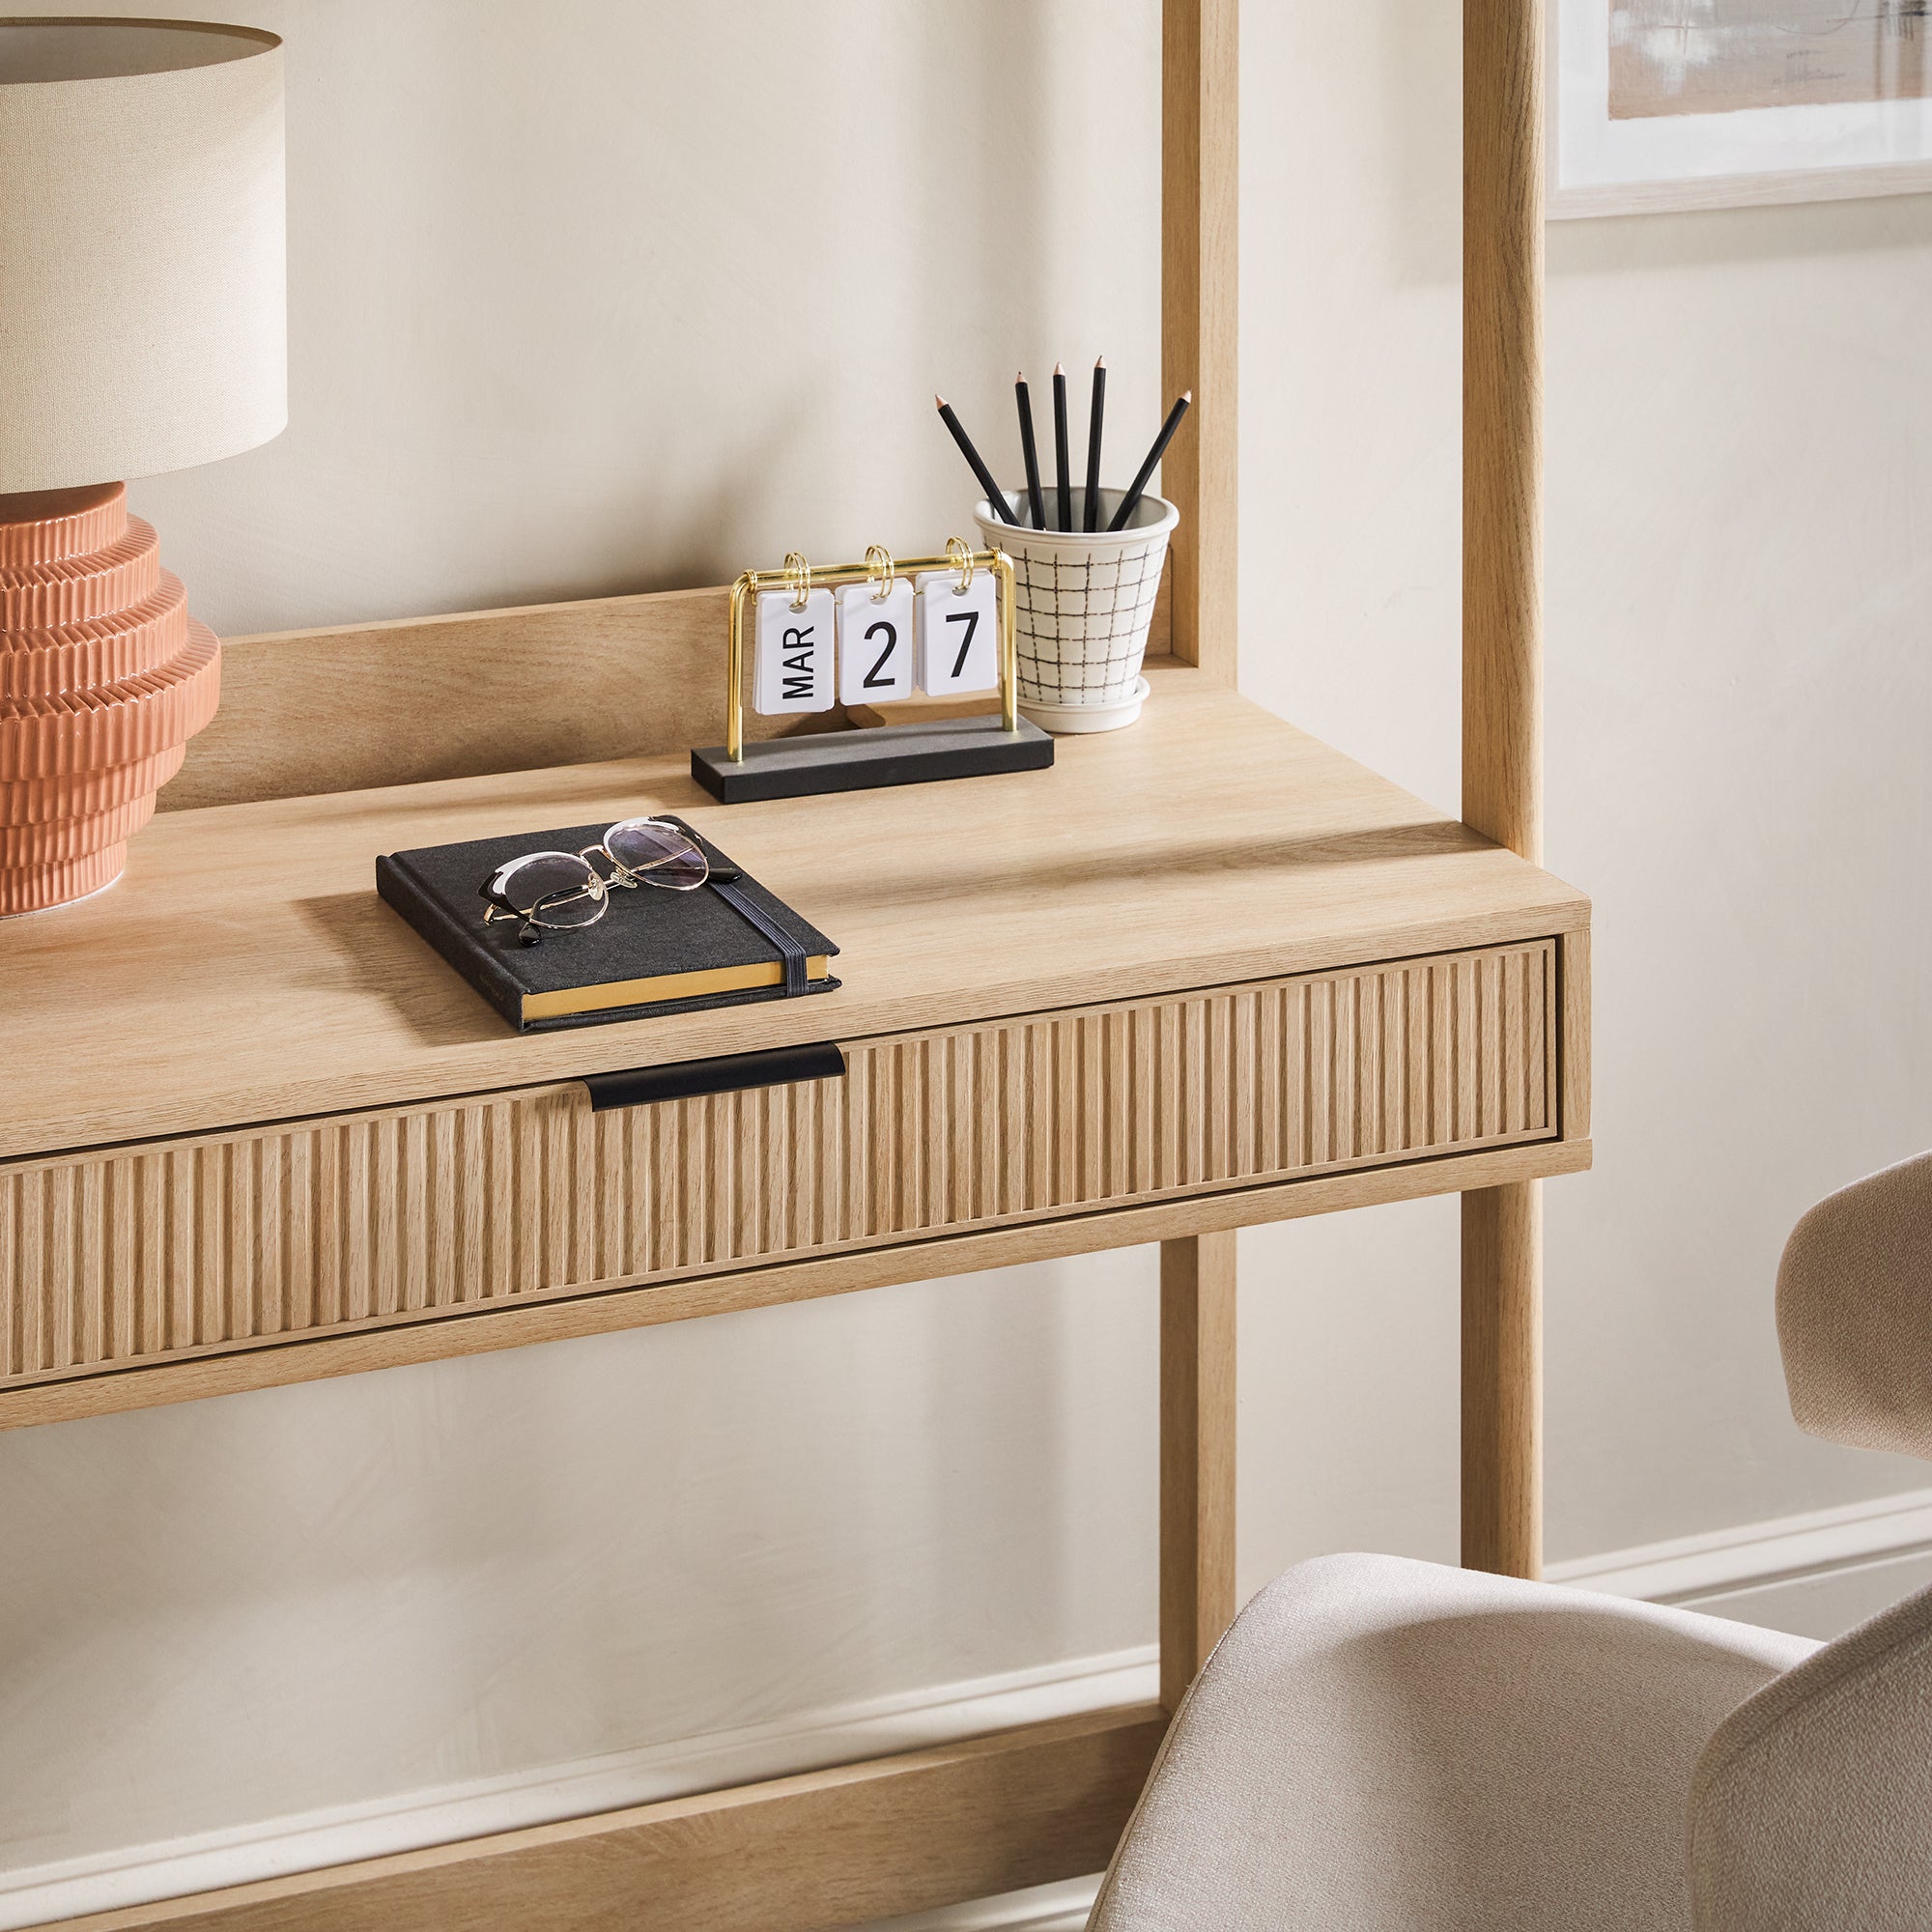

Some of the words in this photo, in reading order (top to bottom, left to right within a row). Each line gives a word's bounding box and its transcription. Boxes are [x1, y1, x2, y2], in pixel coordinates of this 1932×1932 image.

[781, 625, 814, 699] MAR
[863, 621, 896, 689] 2
[946, 611, 980, 678] 7
